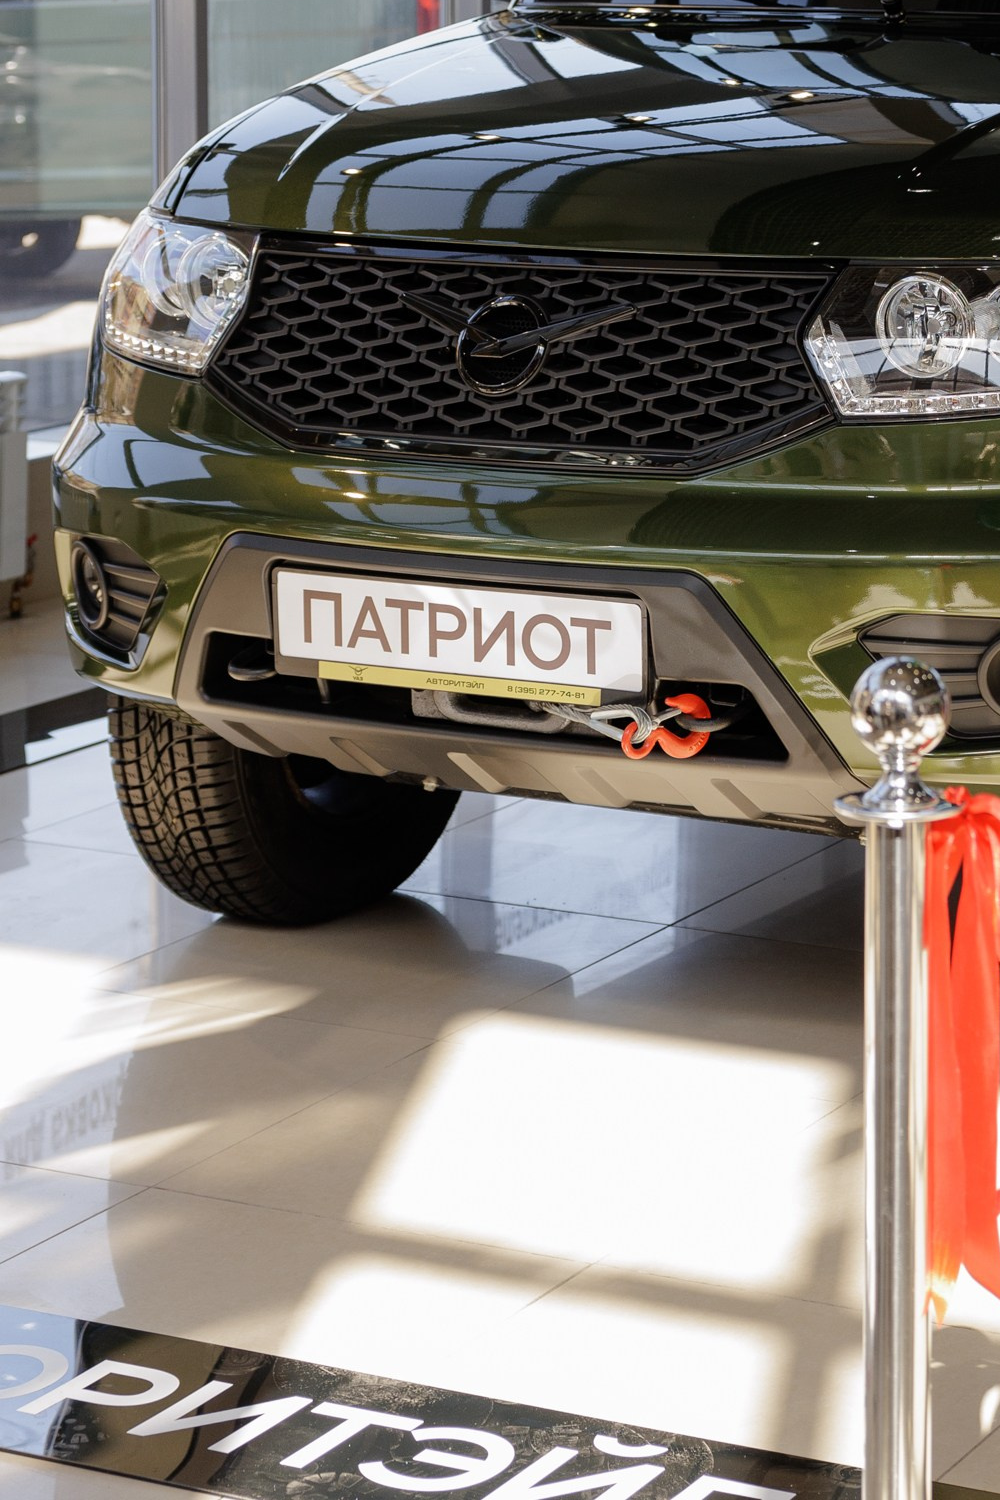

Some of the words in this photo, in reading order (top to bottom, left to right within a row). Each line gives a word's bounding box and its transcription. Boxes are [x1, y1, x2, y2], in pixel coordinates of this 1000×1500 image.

[302, 589, 612, 675] ПАТРИОТ
[426, 677, 485, 690] АВТОРИТЭЙЛ
[507, 685, 513, 693] 8
[514, 684, 537, 696] (395)
[538, 687, 585, 700] 277-74-81
[0, 1344, 796, 1500] РИТЭЙ
